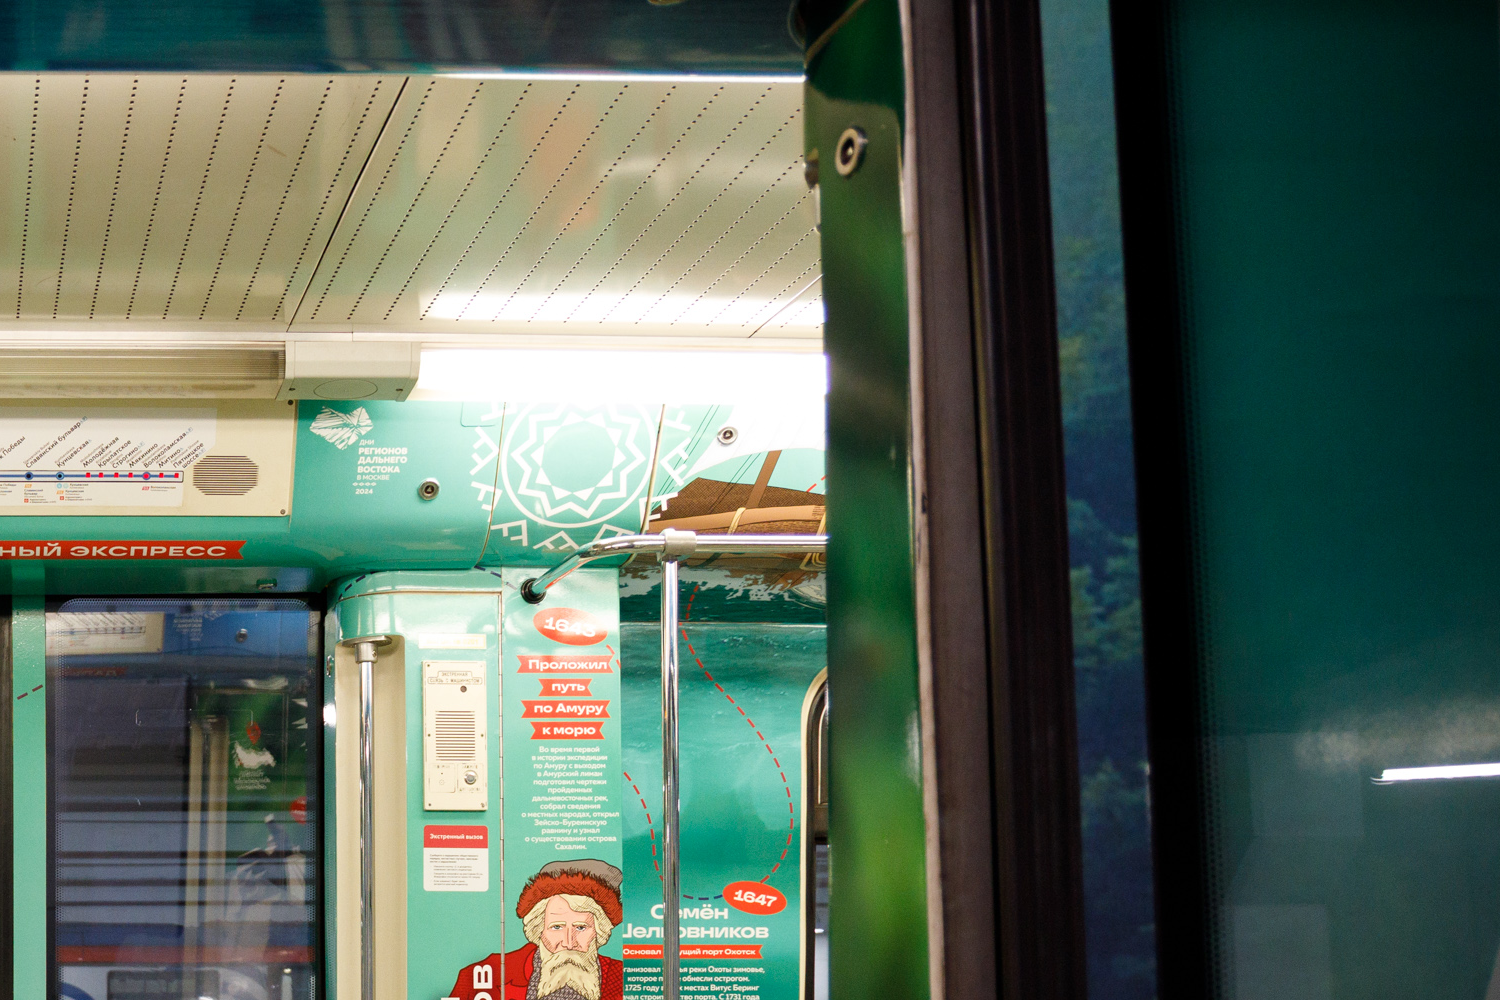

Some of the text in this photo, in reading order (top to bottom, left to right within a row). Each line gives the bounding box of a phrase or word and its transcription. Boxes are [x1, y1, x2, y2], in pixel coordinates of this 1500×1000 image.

[2, 436, 25, 456] Победы
[26, 440, 58, 468] Славянский
[57, 421, 80, 442] бульвар
[83, 437, 119, 468] Молодёжная
[143, 433, 186, 468] Волоколамская
[358, 447, 408, 455] РЕГИОНОВ
[57, 440, 89, 468] Кунцевская
[98, 440, 131, 468] Крылатское
[112, 447, 138, 468] Строгино
[129, 444, 158, 468] Мякинино
[159, 449, 180, 468] Митино
[173, 443, 204, 468] Пятницкое
[357, 456, 408, 465] ДАЛЬНЕГО
[70, 545, 227, 558] ЭКСПРЕСС
[544, 617, 596, 638] 1643
[528, 660, 607, 671] Проложил
[552, 683, 586, 694] путь
[534, 703, 604, 715] по Амуру
[542, 727, 596, 737] к морю
[574, 746, 600, 754] первой
[543, 770, 579, 778] Амурский
[544, 762, 567, 770] Амуру
[733, 889, 777, 907] 1647
[651, 904, 729, 920] Смён
[702, 949, 723, 957] порт
[725, 948, 756, 956] Охотск
[710, 984, 732, 992] Витус
[733, 984, 760, 992] Беринг
